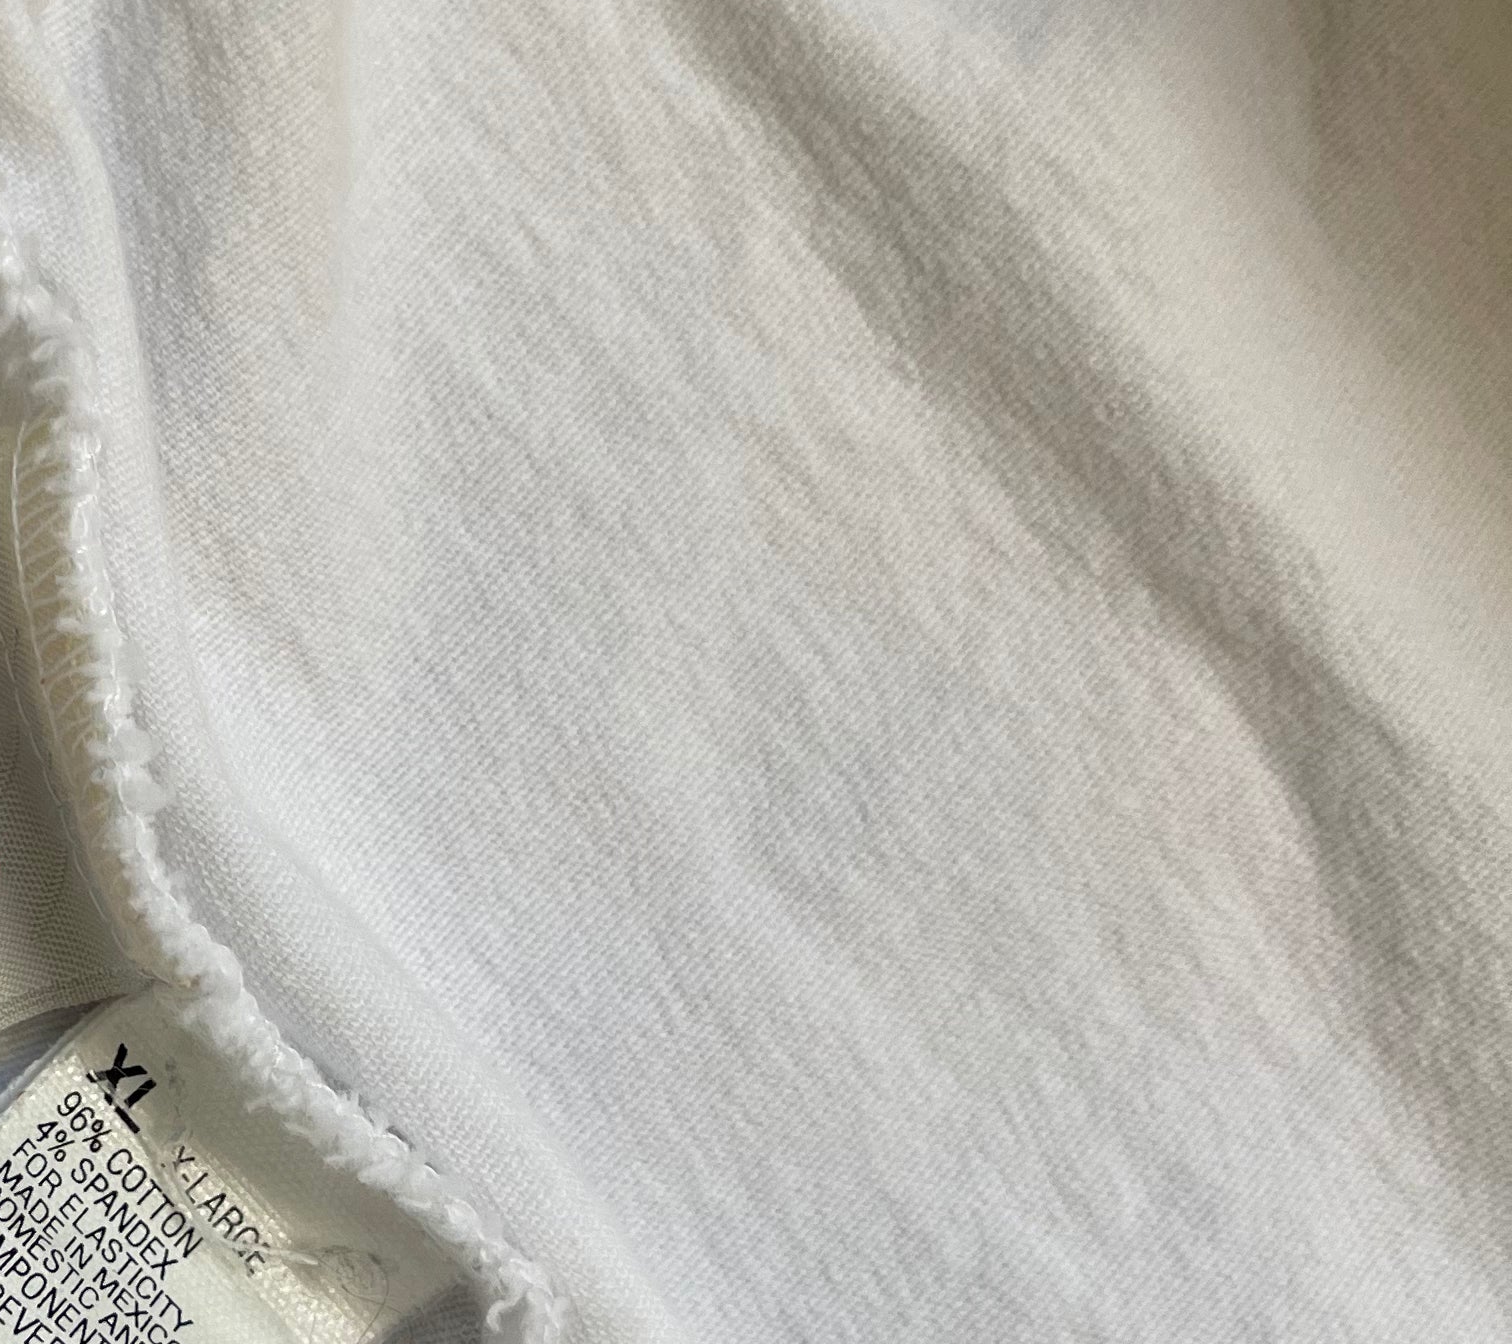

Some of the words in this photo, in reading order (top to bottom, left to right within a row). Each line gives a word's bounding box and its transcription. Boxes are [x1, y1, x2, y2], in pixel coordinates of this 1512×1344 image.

[87, 1043, 157, 1133] XL
[13, 1138, 62, 1198] FOR
[59, 1193, 193, 1332] ELASTICITY
[37, 1121, 75, 1162] 4%
[71, 1158, 178, 1280] SPANDEX
[57, 1091, 112, 1153] 96%
[107, 1148, 203, 1257] COTTON
[64, 1236, 93, 1269] IN
